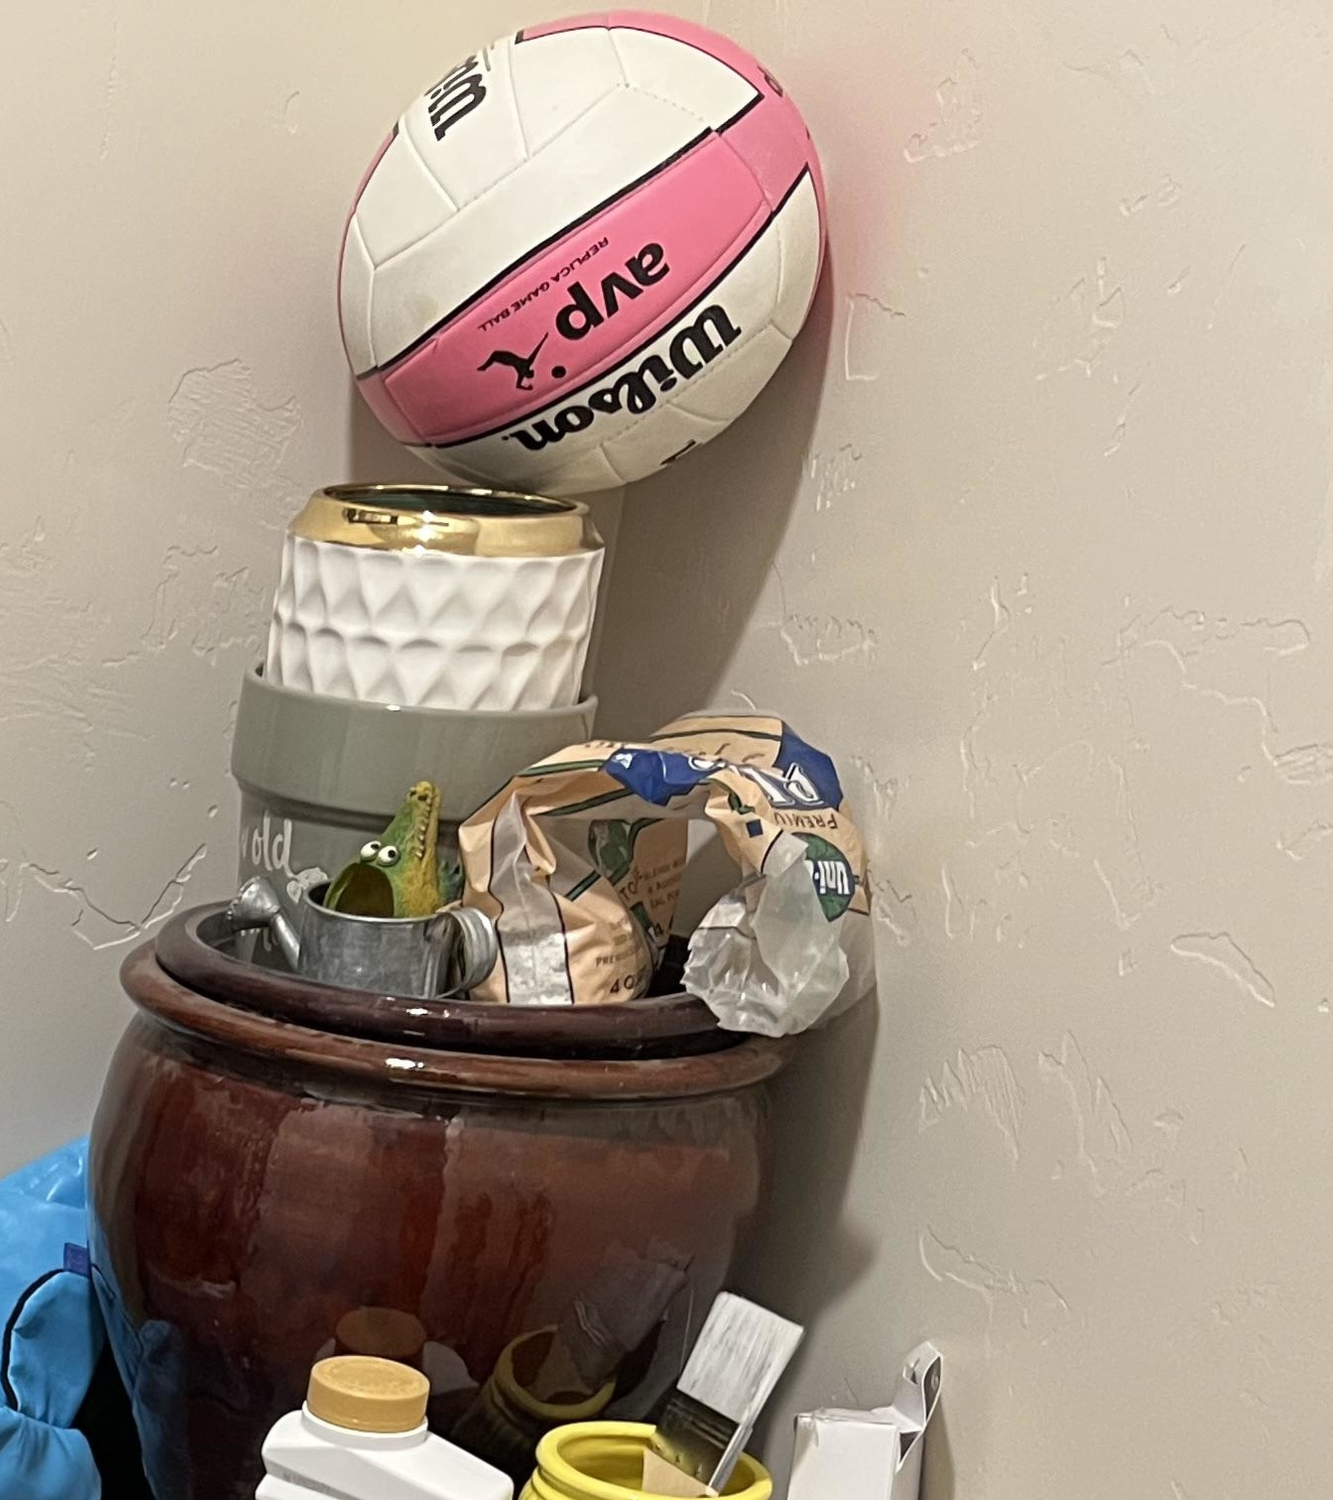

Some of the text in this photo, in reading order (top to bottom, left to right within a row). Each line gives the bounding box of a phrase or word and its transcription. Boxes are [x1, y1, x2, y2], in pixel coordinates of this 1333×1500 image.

[478, 237, 609, 332] REPLICA GAME BALL
[556, 243, 670, 340] avp
[510, 305, 741, 450] Wilson
